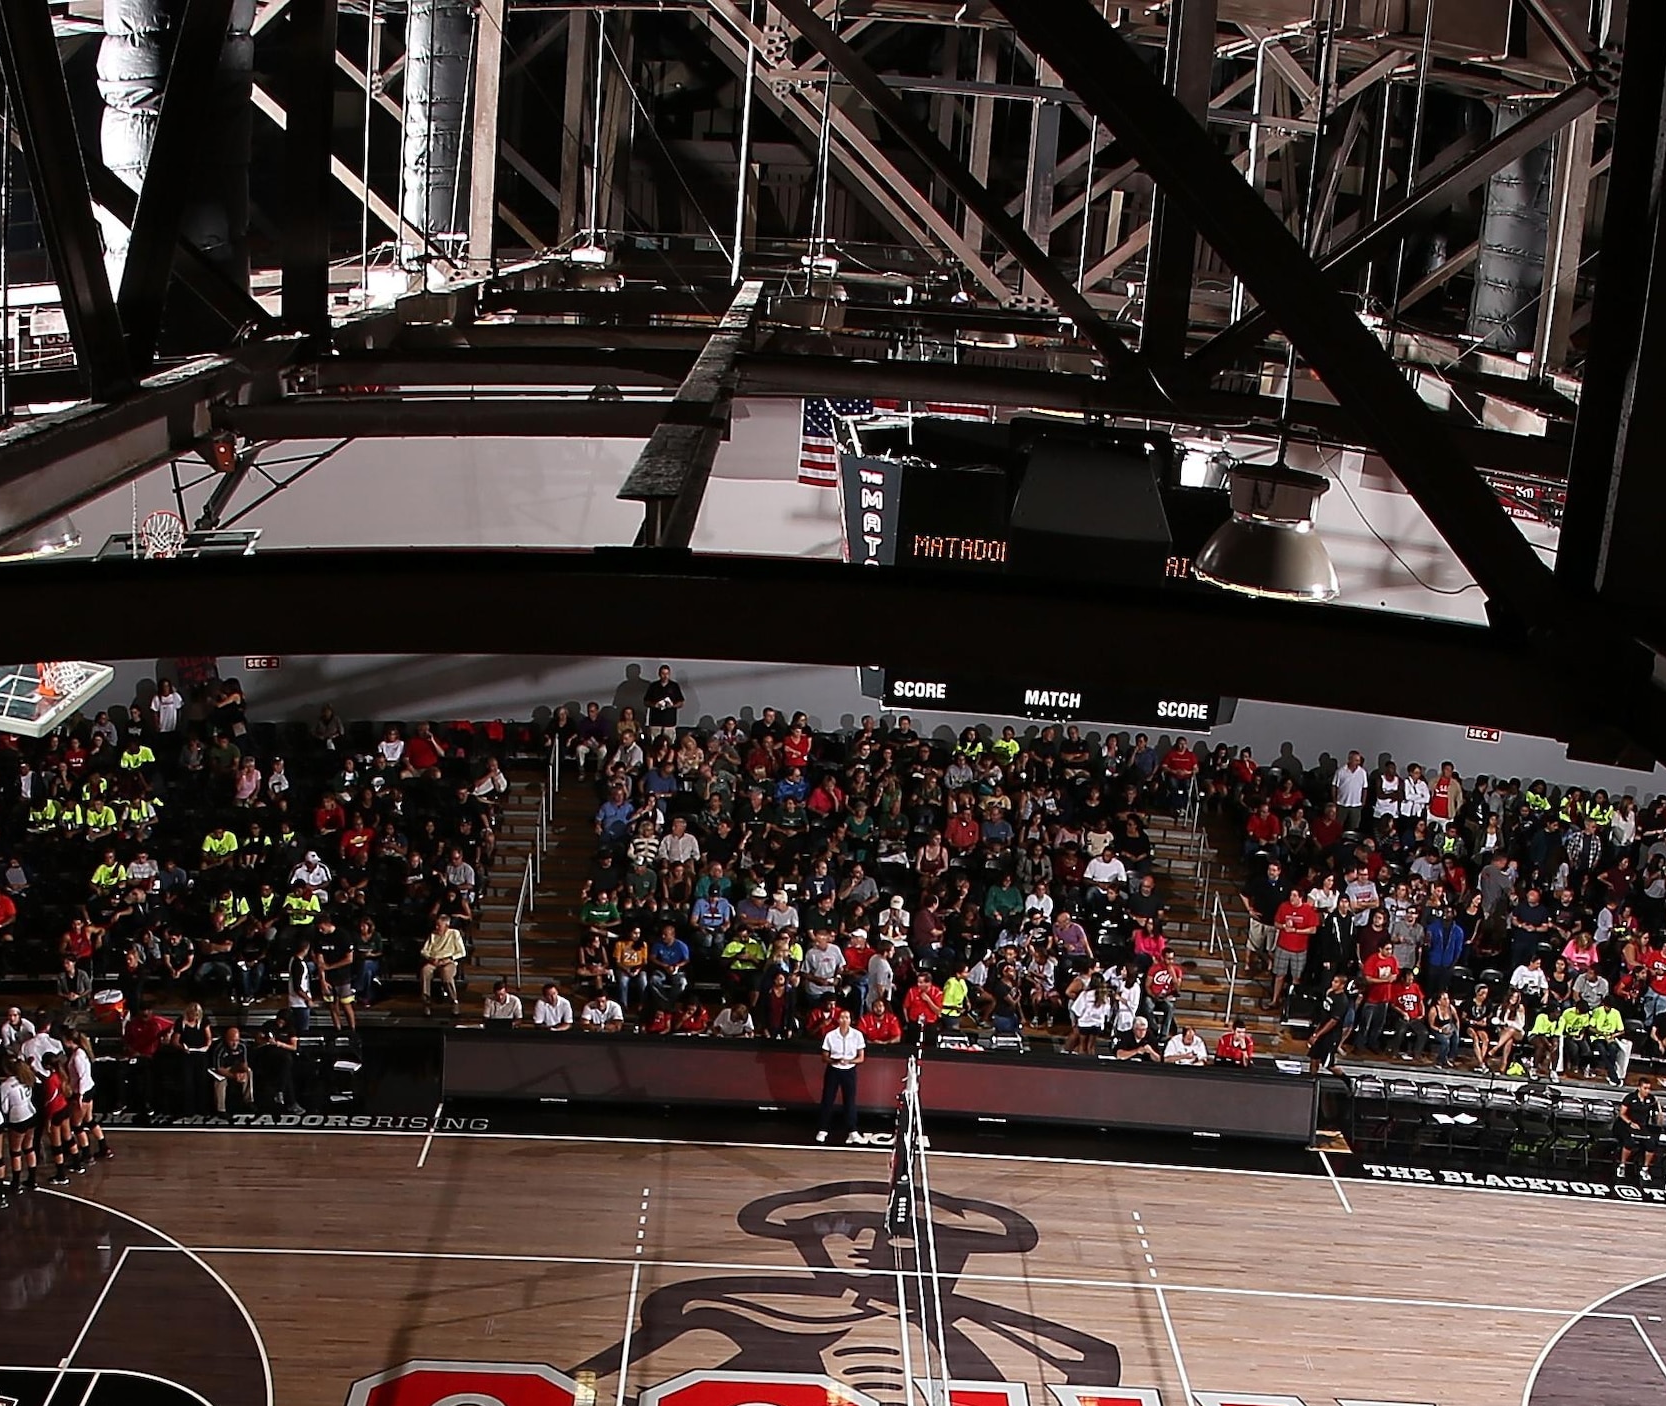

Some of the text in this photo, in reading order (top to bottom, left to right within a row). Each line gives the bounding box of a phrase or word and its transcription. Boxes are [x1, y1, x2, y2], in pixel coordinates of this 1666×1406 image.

[859, 469, 884, 486] THE
[247, 658, 268, 668] SEC
[893, 680, 947, 699] SCORE
[1024, 689, 1082, 708] MATCH
[1156, 701, 1209, 720] SCORE
[1468, 728, 1498, 741] SEC 4
[624, 952, 638, 963] 24
[1363, 1163, 1436, 1182] THE
[1439, 1168, 1613, 1197] BLACKTOP
[1614, 1183, 1644, 1201] @
